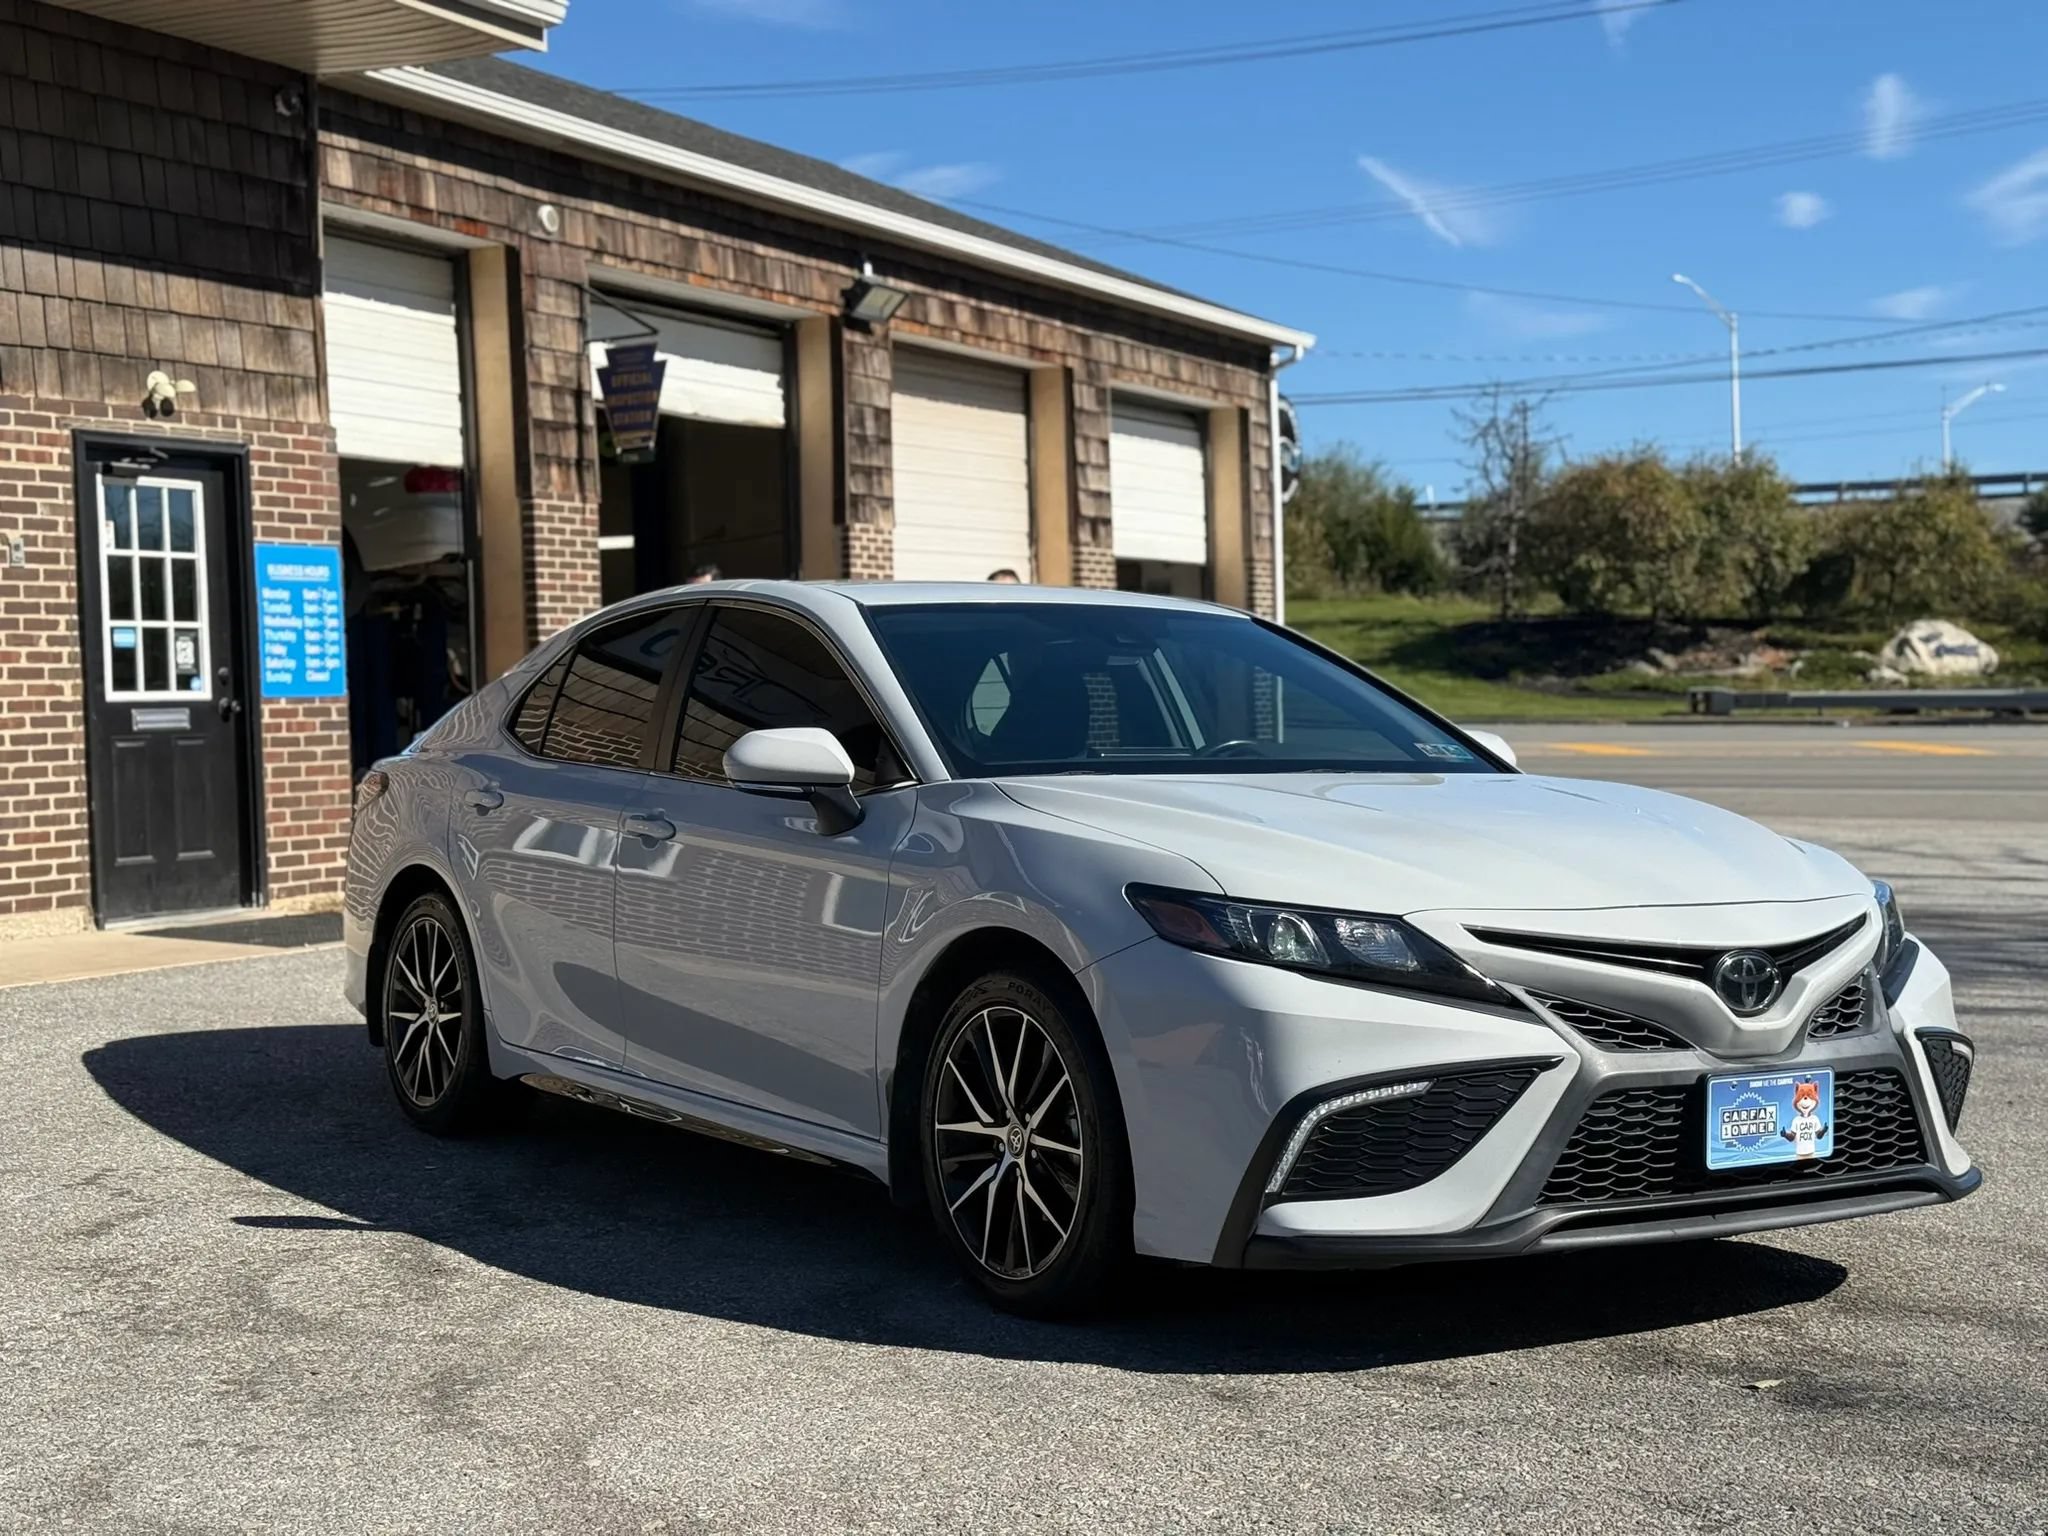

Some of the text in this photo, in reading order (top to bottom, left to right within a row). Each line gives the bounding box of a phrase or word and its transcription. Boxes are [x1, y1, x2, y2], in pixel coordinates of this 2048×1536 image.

[1722, 1108, 1776, 1123] CARFAX
[1731, 1121, 1776, 1136] OWNER
[1800, 1122, 1813, 1131] CAR
[1799, 1132, 1813, 1141] FOX
